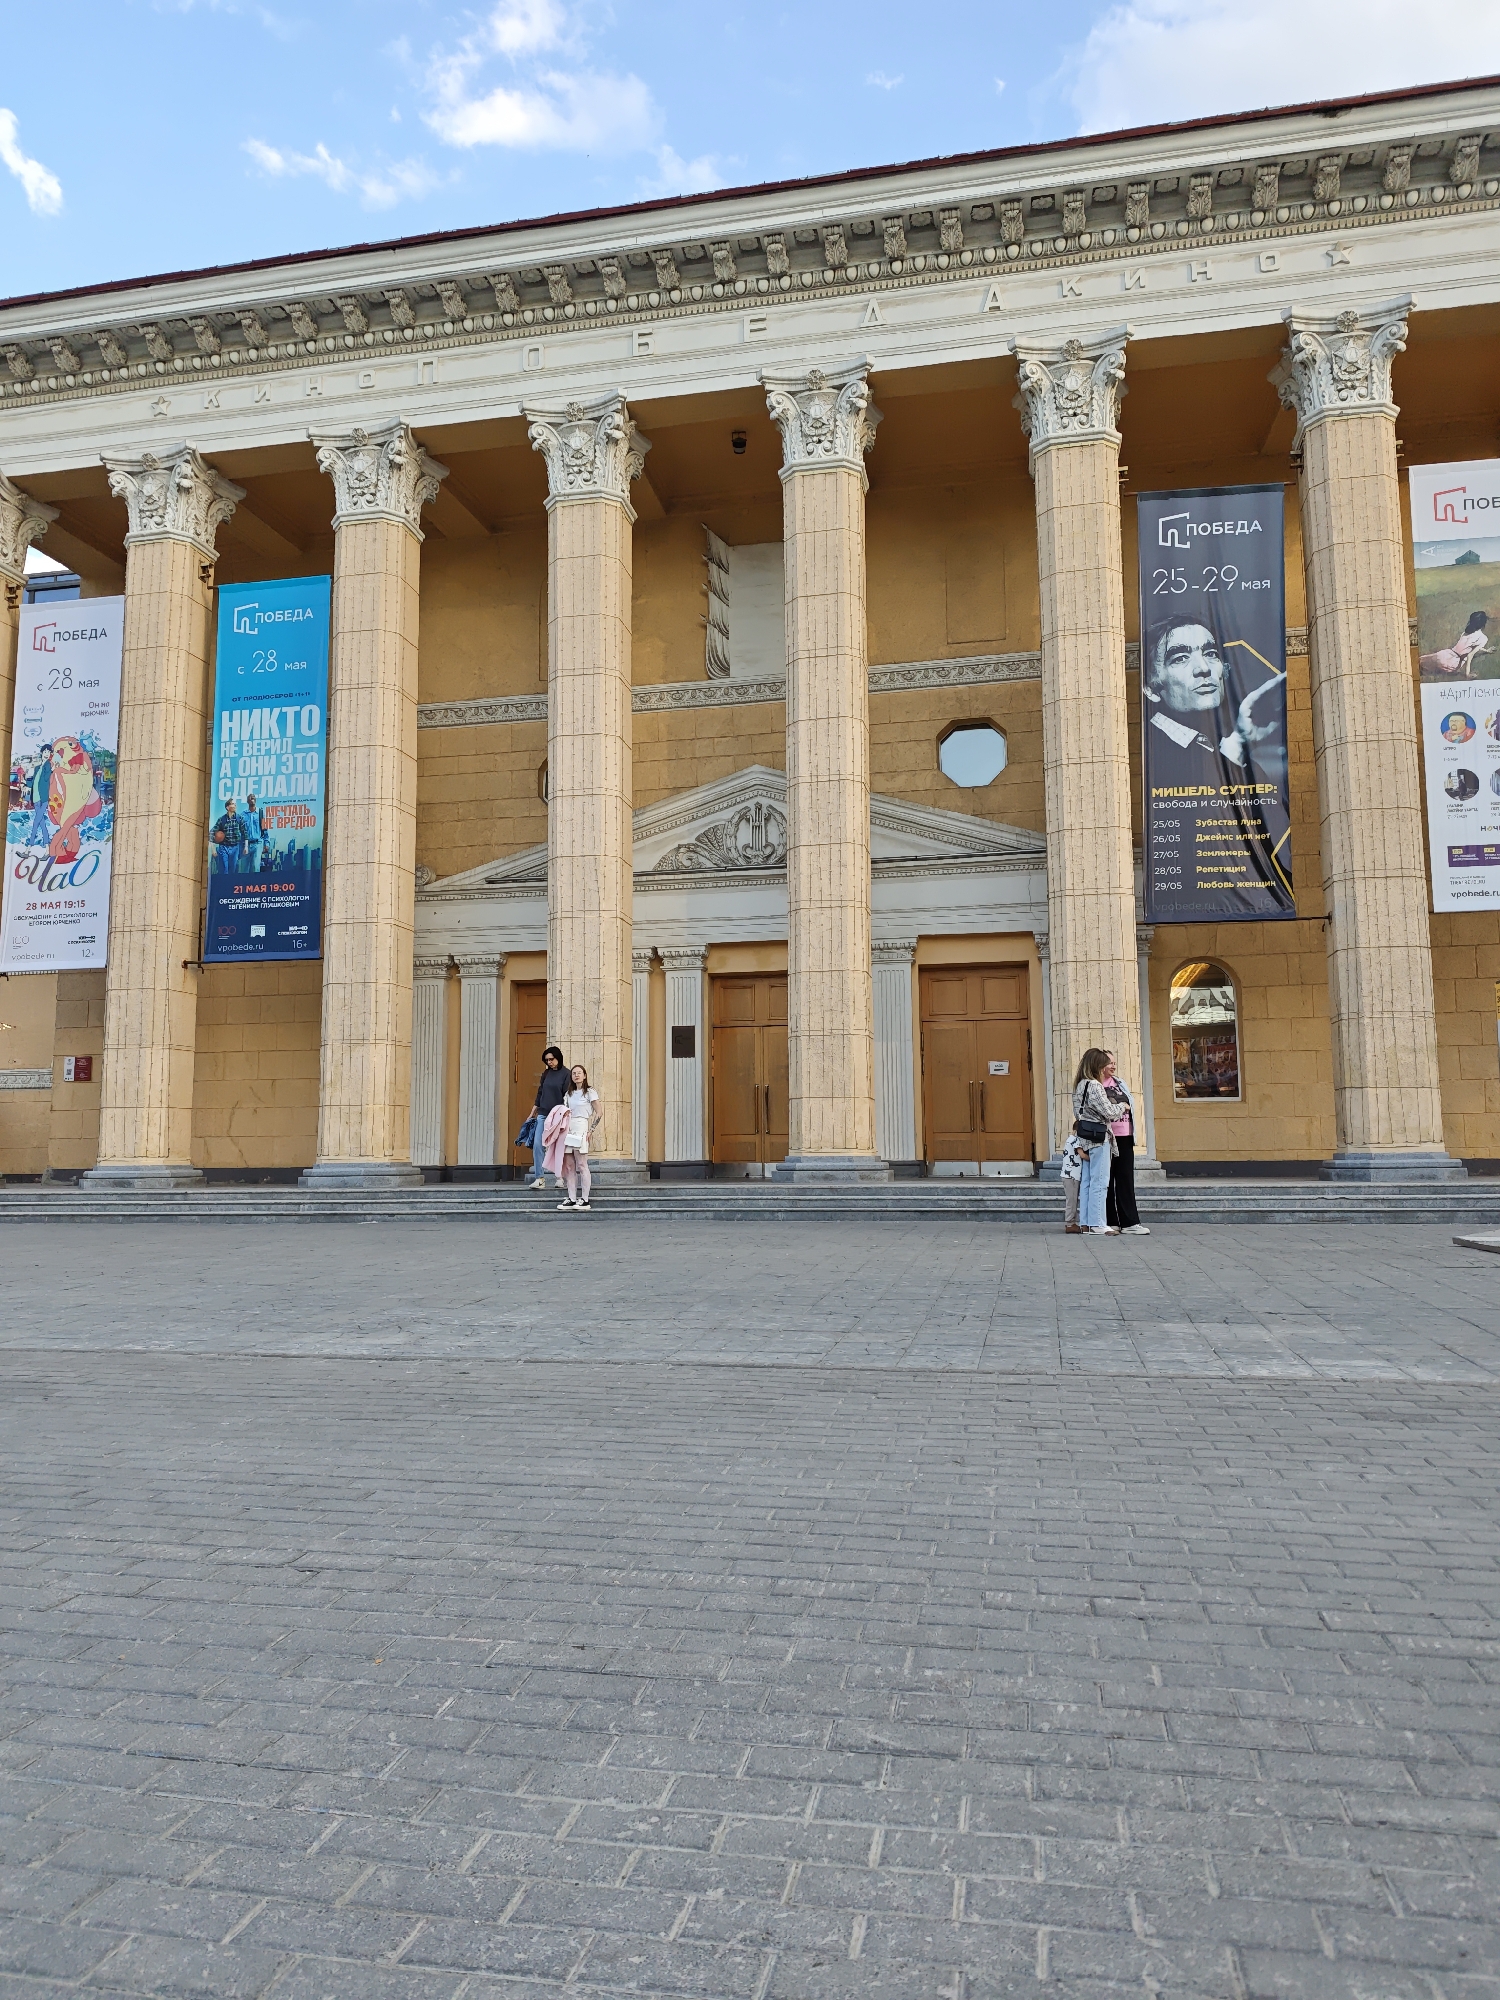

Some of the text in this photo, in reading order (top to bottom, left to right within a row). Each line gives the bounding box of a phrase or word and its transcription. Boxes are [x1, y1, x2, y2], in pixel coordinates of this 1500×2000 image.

[203, 250, 1282, 409] КИНО ПОБЕДА КИНО
[1187, 520, 1262, 536] ПОБЕДА
[1242, 580, 1271, 590] мая
[255, 608, 313, 623] ПОБЕДА
[53, 628, 107, 642] ПОБЕДА
[238, 649, 307, 674] с 28 мая
[37, 667, 100, 691] с 28 мая
[244, 693, 293, 701] ПРОДЮСЕРОВ
[221, 704, 320, 742] НИКТО
[220, 741, 239, 758] НЕ
[243, 738, 292, 756] ВЕРИЛ
[220, 752, 319, 778] А ОНИ ЭТО
[218, 772, 318, 804] СДЕЛАЛИ
[1152, 784, 1277, 797] МИШЕЛЬ СУТТЕР:
[1153, 800, 1197, 809] свобода
[1210, 798, 1277, 808] случайность
[265, 804, 310, 818] МЕЧТАТЬ
[261, 815, 316, 830] НЕ ВРЕДНО
[1153, 819, 1261, 829] 25/05 Зубастая луна
[1153, 835, 1180, 843] 26/05
[1195, 833, 1233, 842] Джеймс
[1153, 850, 1180, 859] 27/05
[1154, 865, 1246, 875] 28/05 Репетиция
[234, 883, 295, 894] 21 МАЯ 19:00
[1154, 880, 1276, 891] 29/05 Любовь женщин
[26, 900, 86, 911] 28 МАЯ 19:15
[218, 940, 307, 952] vpobede.ru 16+
